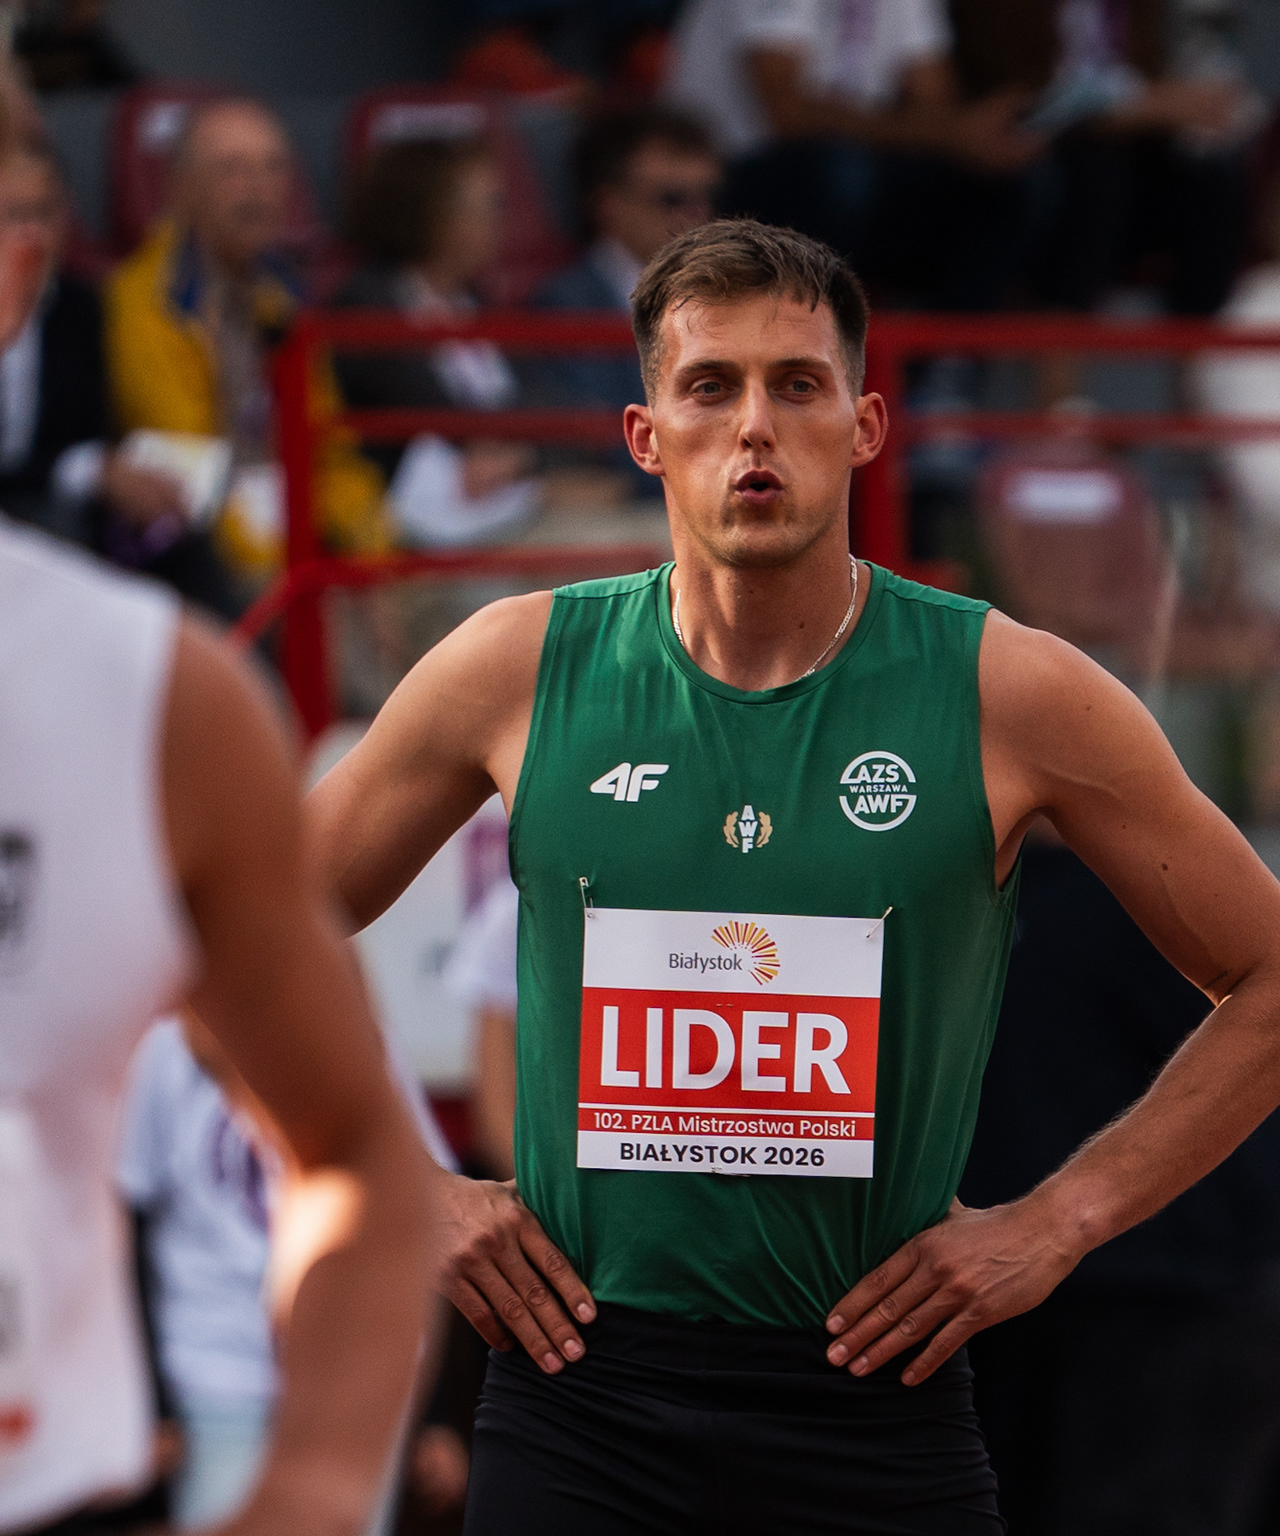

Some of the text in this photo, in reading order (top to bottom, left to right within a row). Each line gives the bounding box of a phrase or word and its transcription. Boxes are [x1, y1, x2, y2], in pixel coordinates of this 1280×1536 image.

[590, 762, 670, 802] 4F
[857, 764, 900, 783] AZS
[849, 784, 908, 793] WARSZAWA
[854, 794, 904, 814] AWF
[668, 951, 743, 973] Białystok
[600, 1005, 852, 1095] LIDER
[594, 1112, 856, 1138] 102. PZLA Mistrzostwa Polski
[620, 1142, 825, 1167] BIAŁYSTOK 2026
